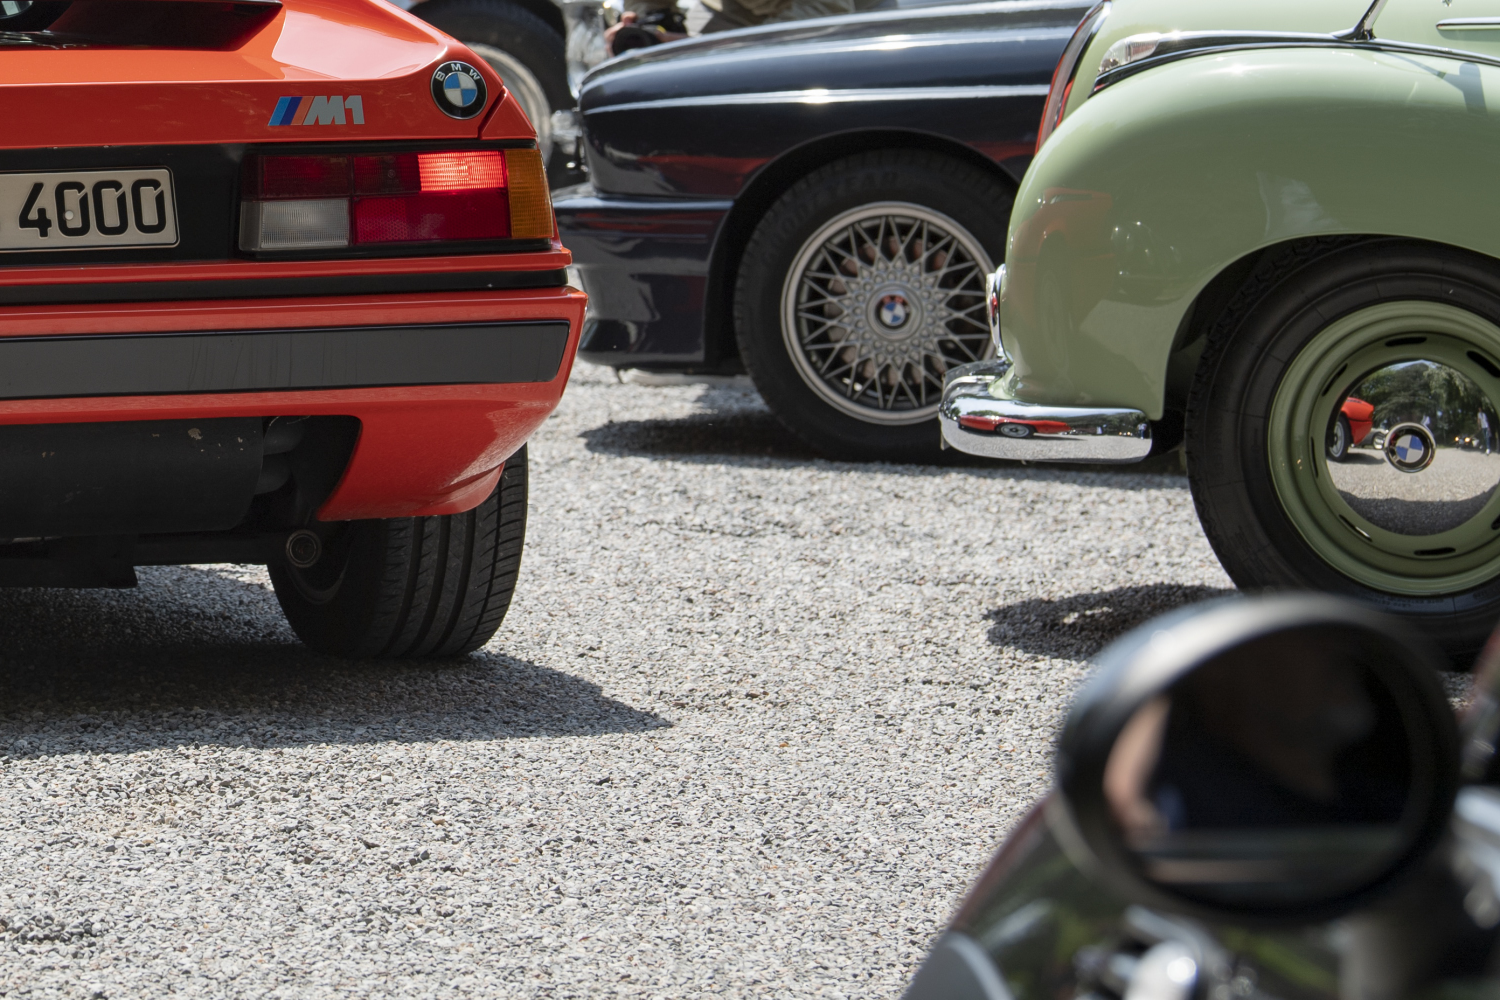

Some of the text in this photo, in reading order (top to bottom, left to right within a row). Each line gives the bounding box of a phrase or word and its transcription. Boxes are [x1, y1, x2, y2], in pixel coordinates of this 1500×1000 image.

[435, 63, 480, 81] BMW
[303, 95, 365, 125] M1
[18, 178, 167, 239] 4000
